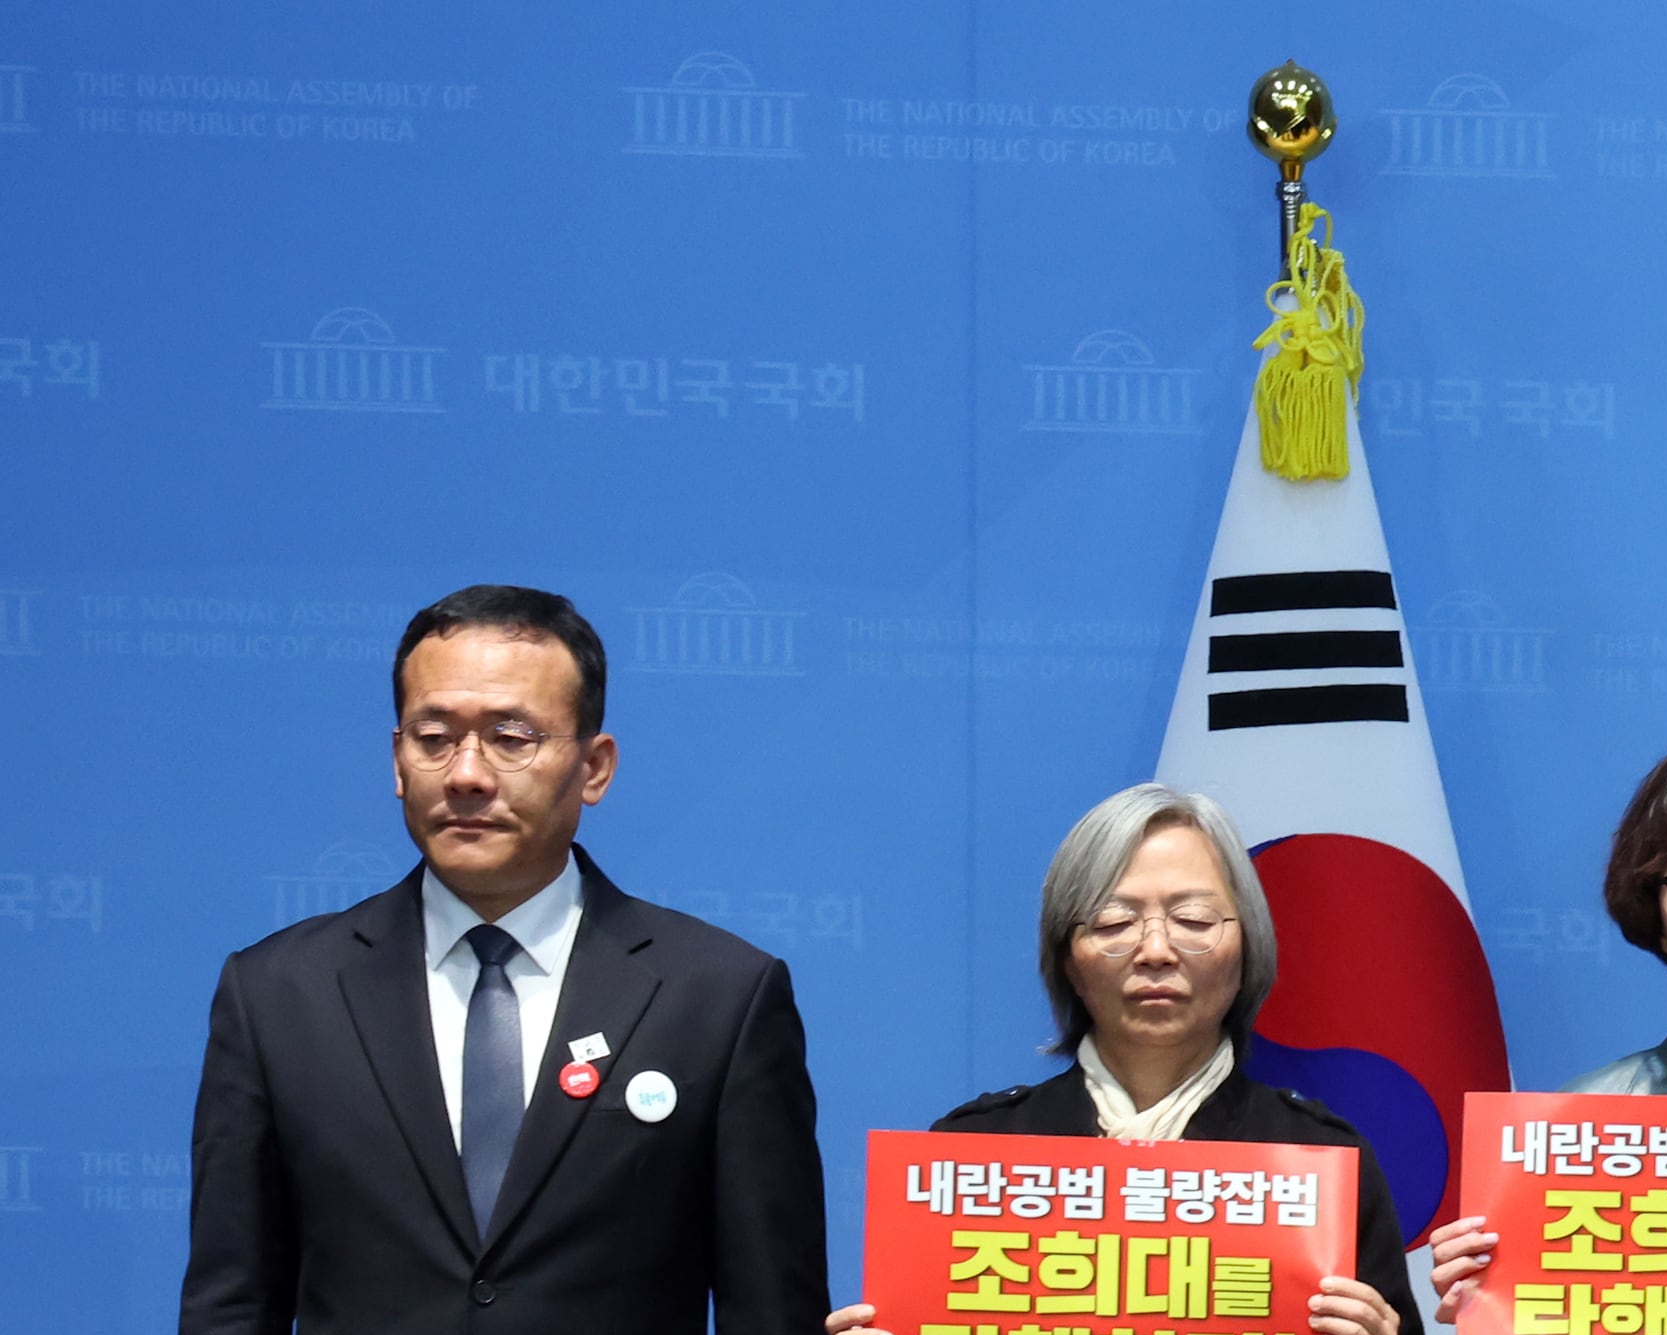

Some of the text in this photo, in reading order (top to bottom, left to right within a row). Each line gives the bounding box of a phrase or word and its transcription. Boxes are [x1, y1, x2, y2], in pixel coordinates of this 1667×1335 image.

[74, 72, 480, 111] THE NATIONAL ASSEMBLY OF
[76, 106, 416, 143] THE REPUBLIC OF KOREA
[842, 98, 1239, 133] THE NATIONAL ASSEMBLY OF
[845, 133, 1176, 167] THE REPUBLIC OF KOREA
[483, 352, 867, 423] 대한민국국회
[907, 1160, 1318, 1227] 내란공범 불량잡범
[947, 1230, 1272, 1319] 조희대를
